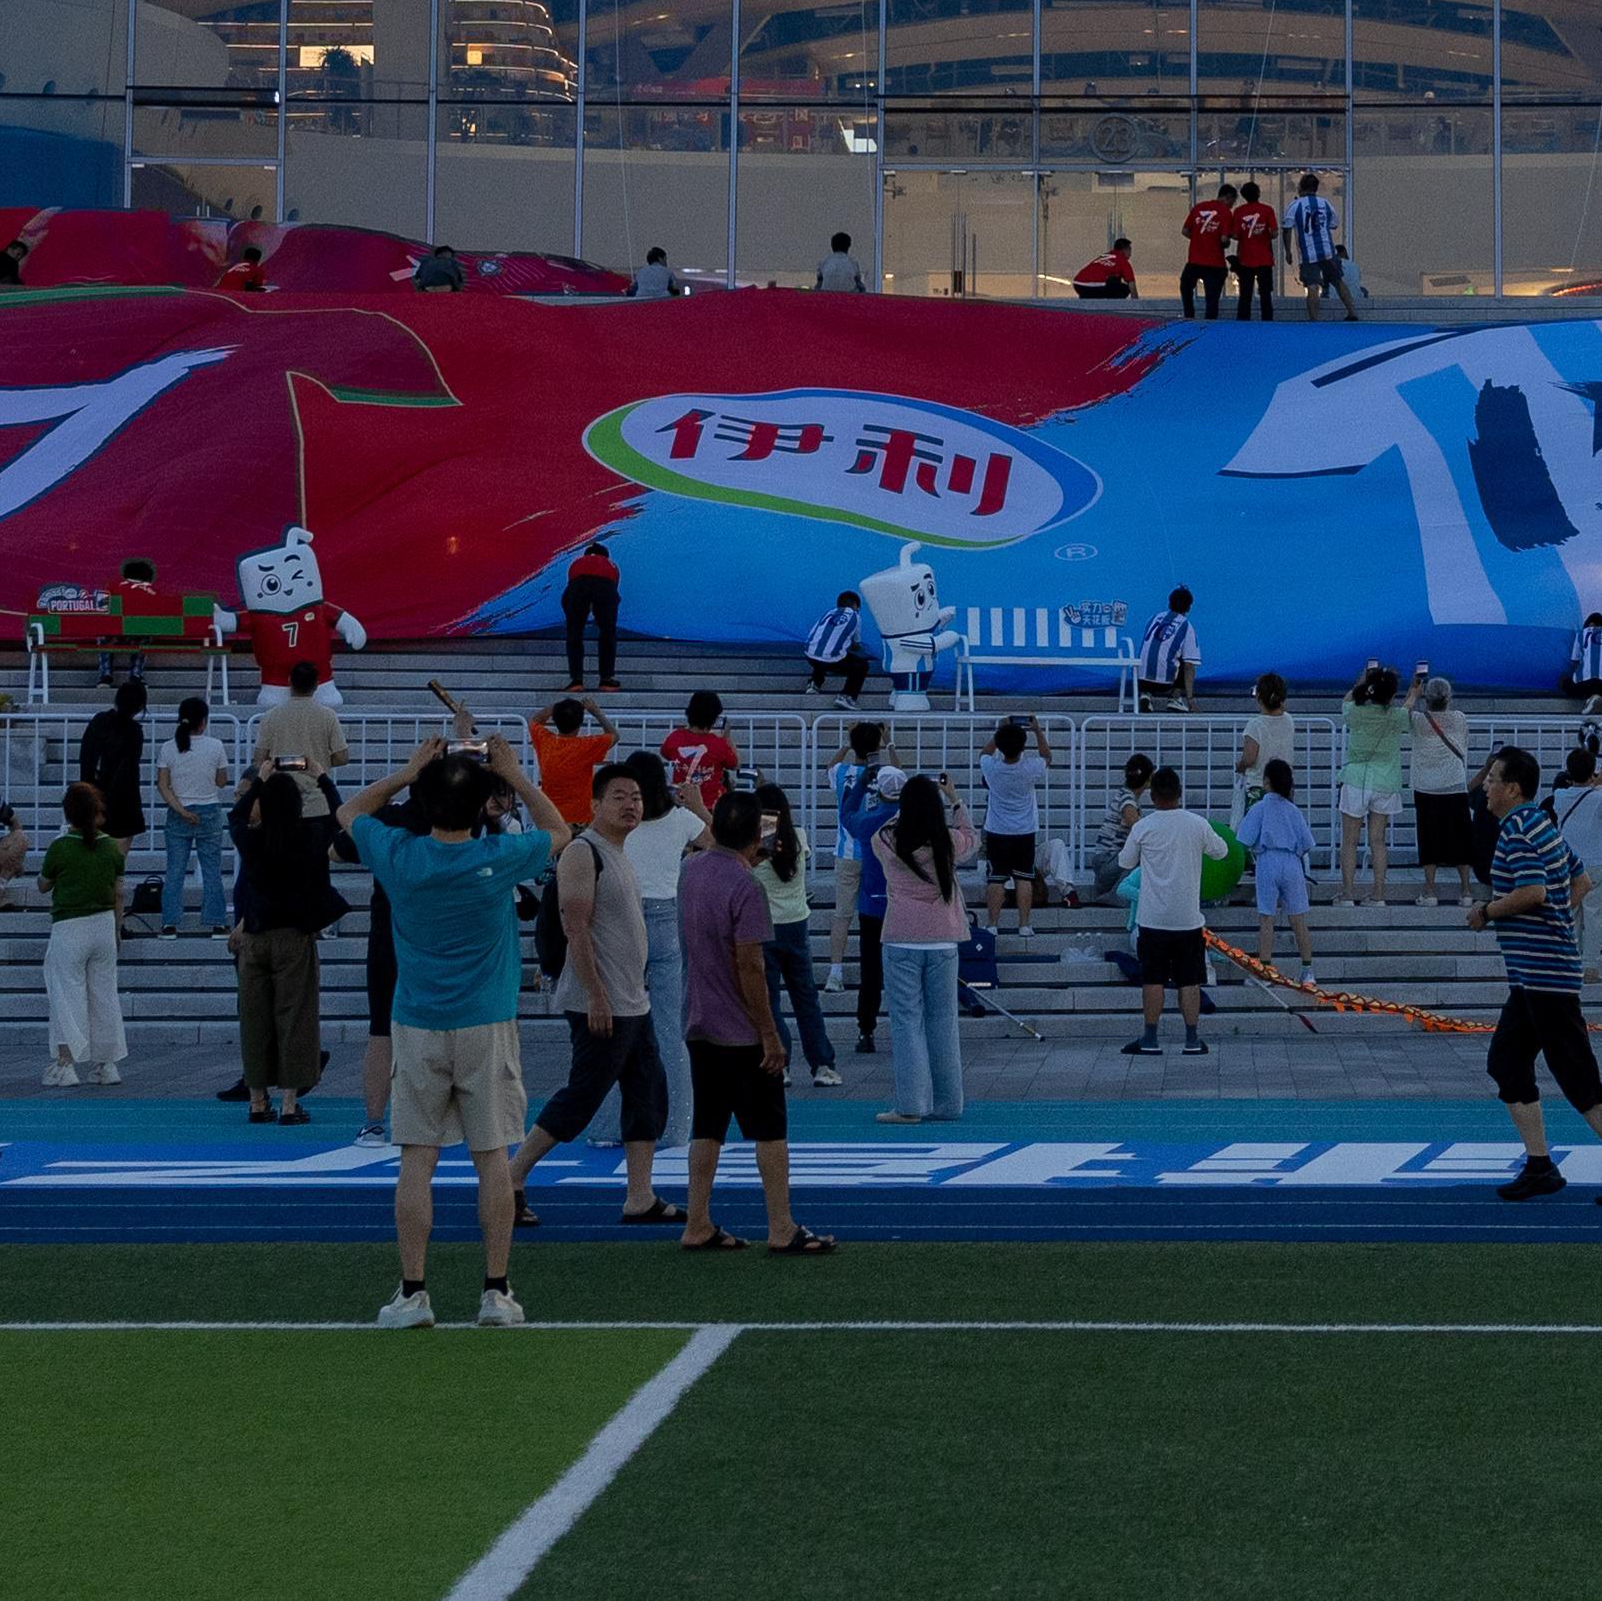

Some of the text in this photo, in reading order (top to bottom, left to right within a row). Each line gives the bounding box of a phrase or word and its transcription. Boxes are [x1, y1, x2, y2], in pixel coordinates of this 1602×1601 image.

[656, 408, 1014, 518] 伊利
[51, 599, 95, 612] PORTUGAL
[282, 621, 299, 648] 7
[677, 743, 709, 784] 7
